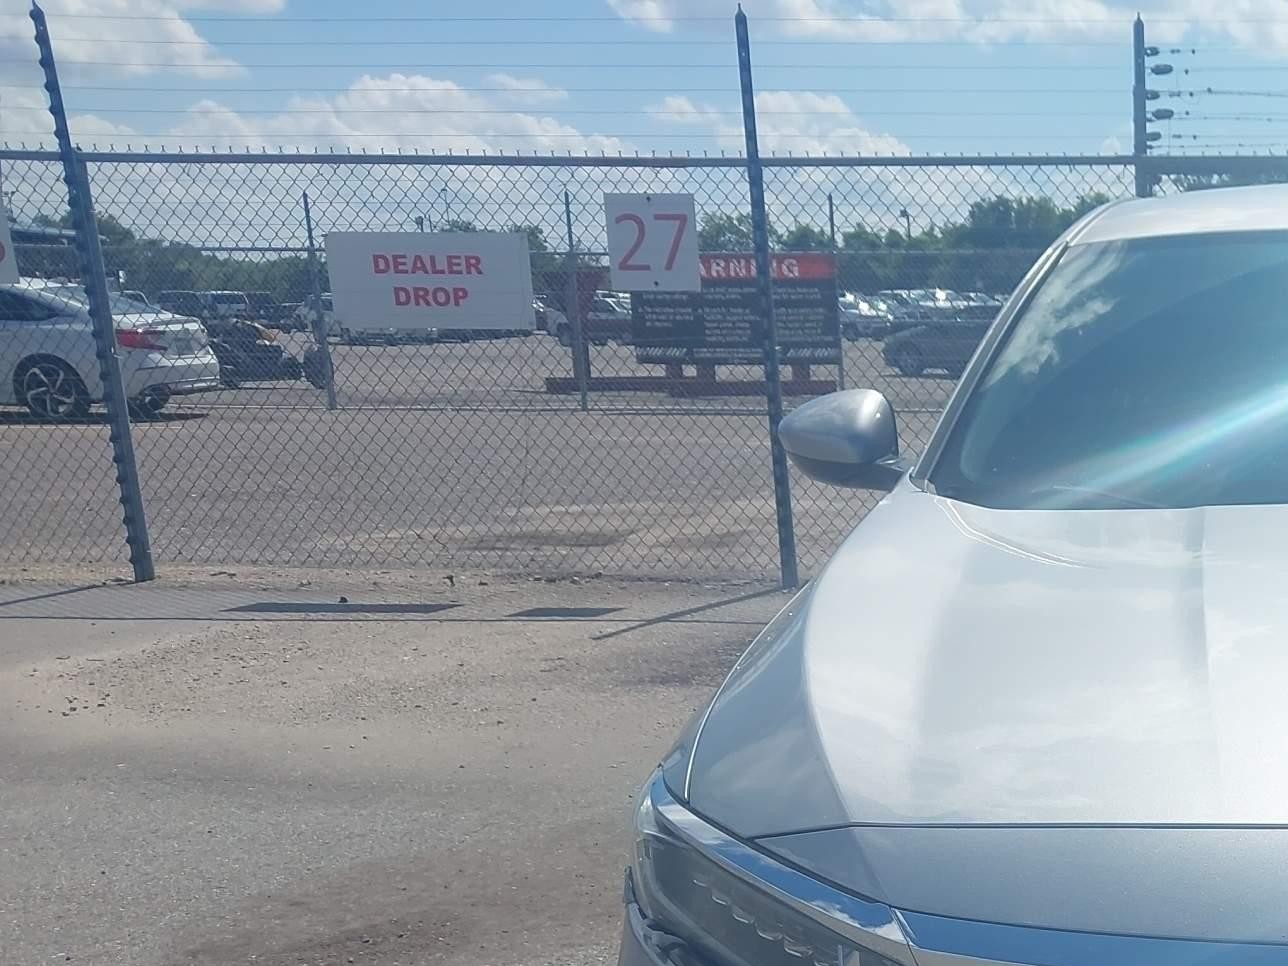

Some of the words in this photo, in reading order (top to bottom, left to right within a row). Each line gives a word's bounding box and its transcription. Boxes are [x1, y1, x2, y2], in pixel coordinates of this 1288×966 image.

[614, 213, 688, 271] 27
[372, 254, 484, 275] DEALER
[700, 257, 800, 277] RNIG
[393, 286, 469, 307] DROP
